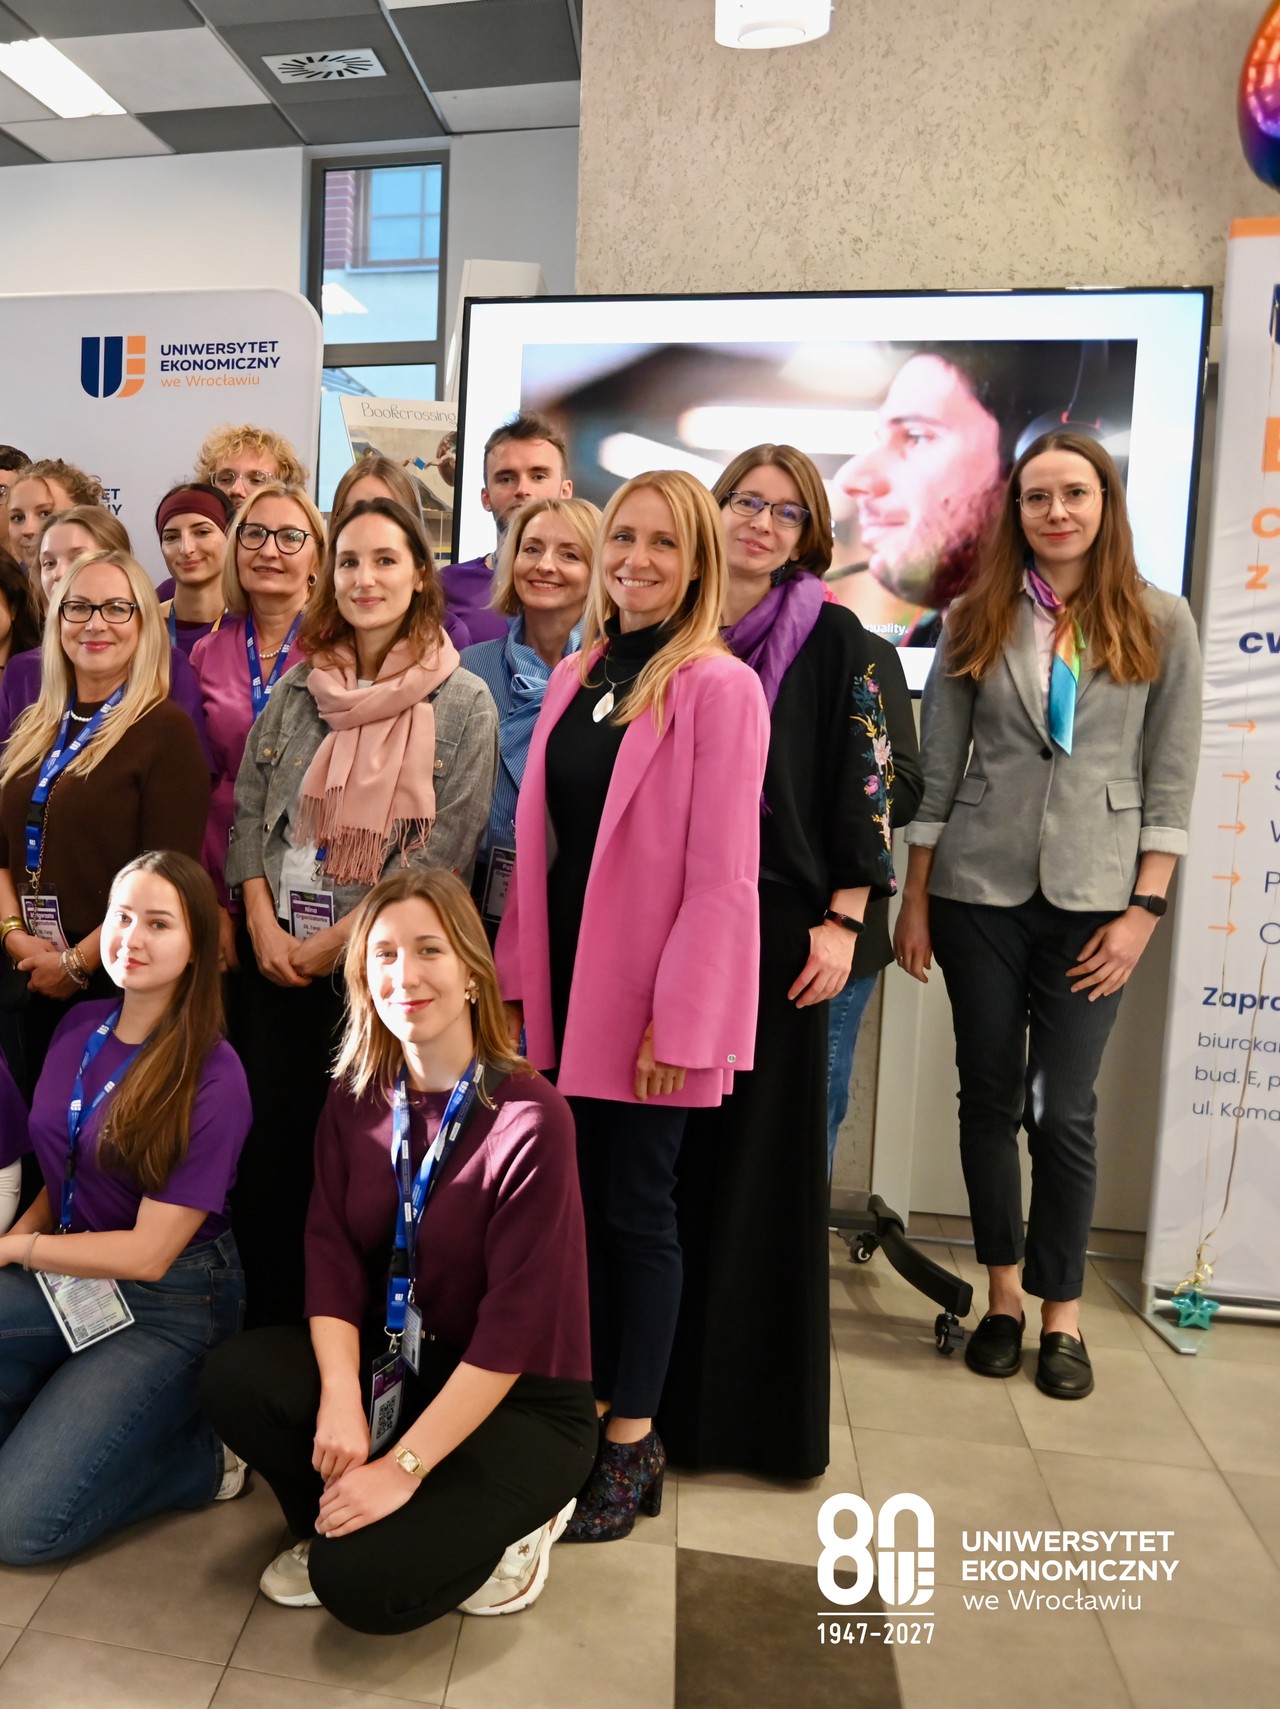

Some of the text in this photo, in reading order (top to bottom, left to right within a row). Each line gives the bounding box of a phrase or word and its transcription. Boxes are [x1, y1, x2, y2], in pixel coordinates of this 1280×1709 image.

[160, 341, 278, 356] UNIWERSYTET
[160, 356, 280, 372] EKONOMICZNY
[160, 373, 260, 387] we Wrocławiu
[361, 402, 456, 425] Bookcrossing
[1202, 986, 1280, 1015] Zapro
[1195, 1065, 1240, 1084] bud.
[1248, 1071, 1261, 1088] E,
[1192, 1100, 1280, 1121] ul. Koma
